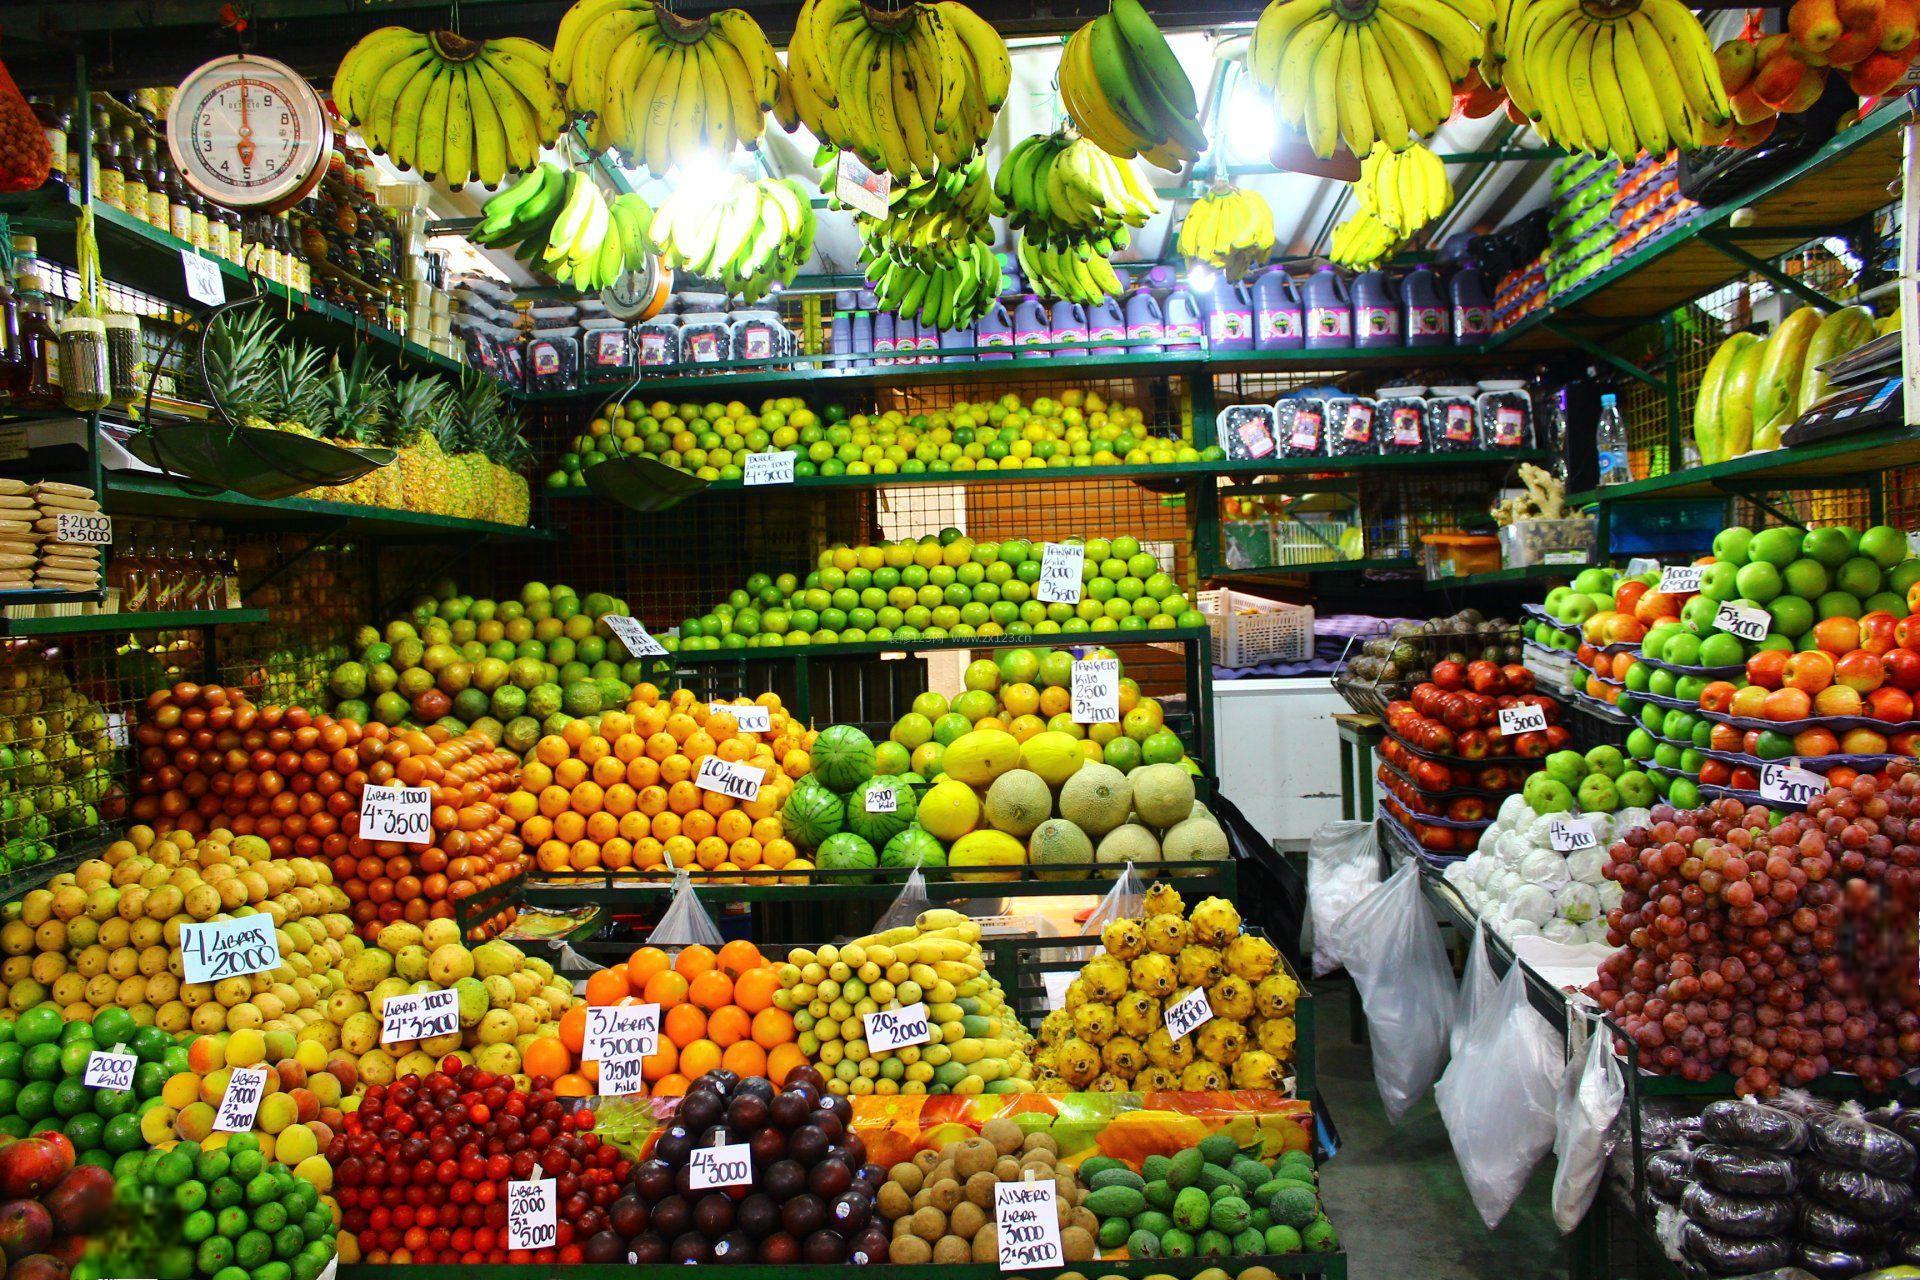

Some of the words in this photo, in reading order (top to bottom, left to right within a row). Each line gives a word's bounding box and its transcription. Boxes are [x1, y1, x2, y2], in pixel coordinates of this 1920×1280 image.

[264, 95, 272, 107] 9
[203, 114, 211, 126] 2
[281, 113, 289, 125] 8
[204, 140, 212, 152] 3
[283, 139, 290, 151] 7
[221, 160, 229, 172] 4
[243, 167, 251, 180] 5
[400, 791, 427, 804] 1000
[183, 928, 206, 966] 4
[420, 993, 453, 1011] 1000
[588, 1009, 608, 1035] 3
[90, 1057, 132, 1073] 2000
